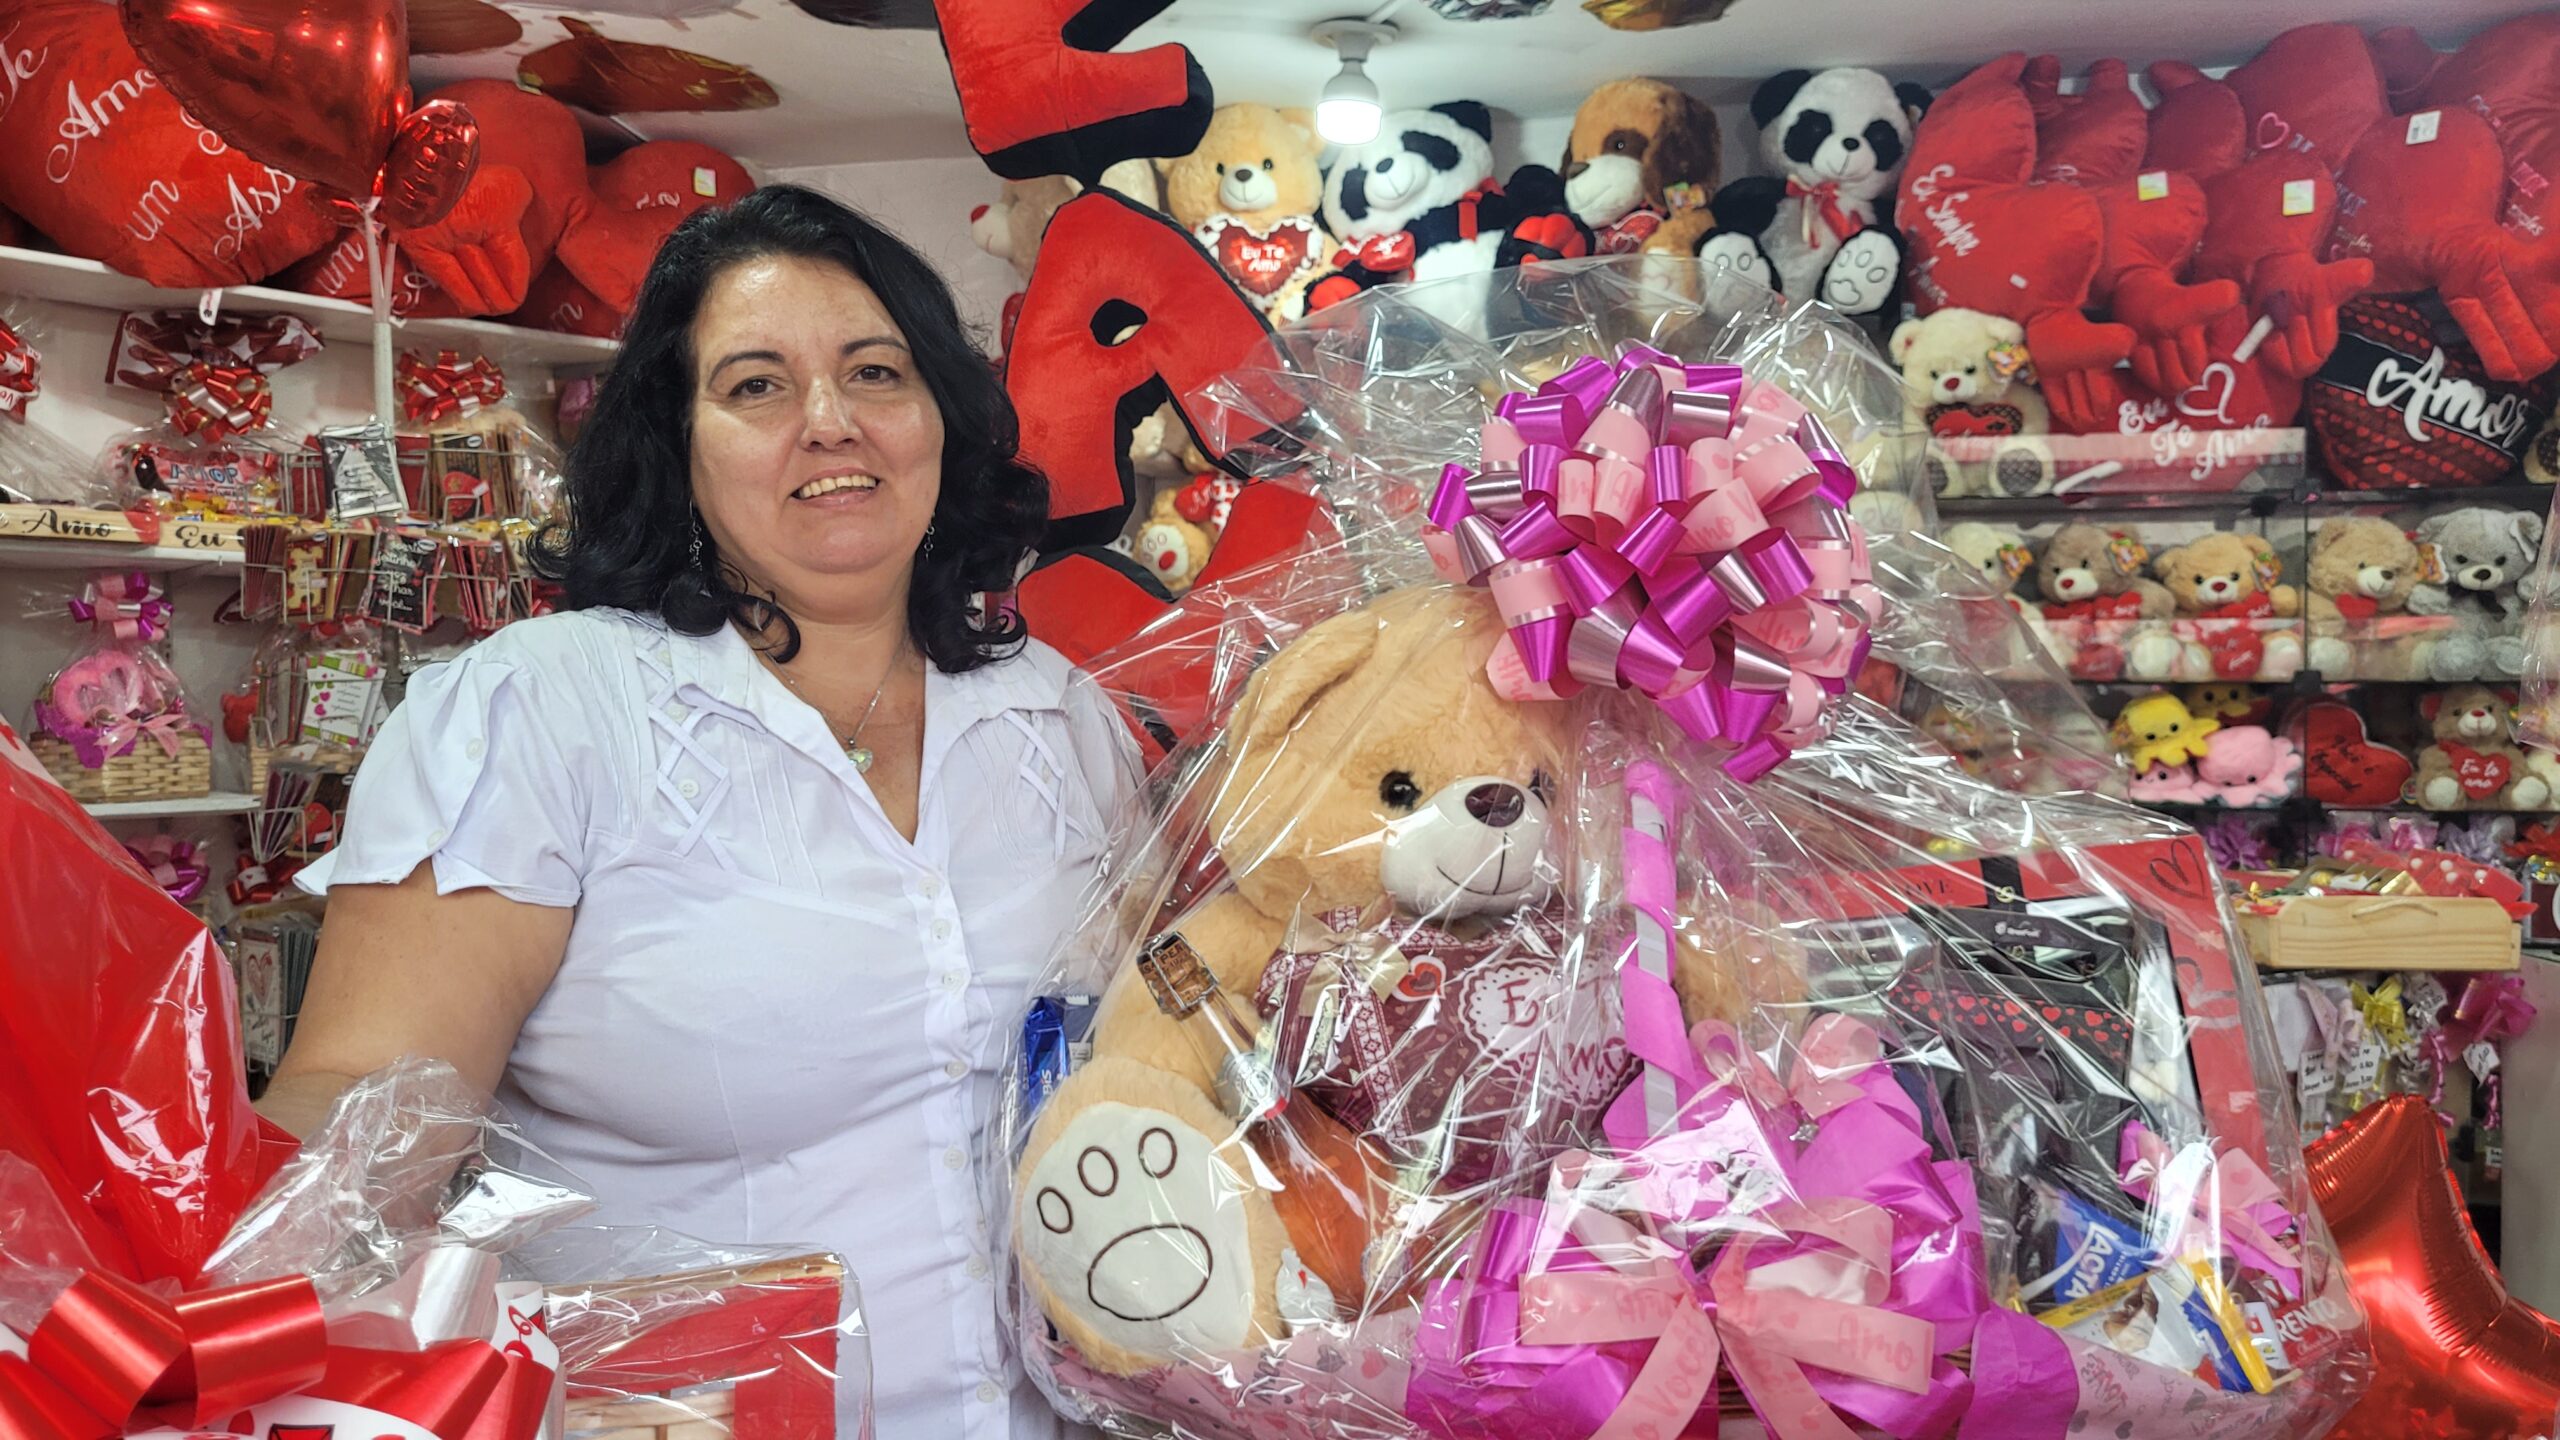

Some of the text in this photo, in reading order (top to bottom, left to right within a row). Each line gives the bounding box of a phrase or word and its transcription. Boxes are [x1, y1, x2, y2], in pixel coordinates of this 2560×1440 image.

[127, 179, 180, 242] um
[1241, 243, 1286, 260] Eu Te
[1249, 258, 1282, 272] Amo
[2118, 398, 2169, 437] Eu
[2366, 344, 2530, 450] Amor
[2150, 418, 2195, 467] Te
[2190, 412, 2273, 481] Amo
[22, 508, 228, 550] Amo Eu
[2063, 1220, 2122, 1300] LACTA
[1837, 1312, 1915, 1373] Amo
